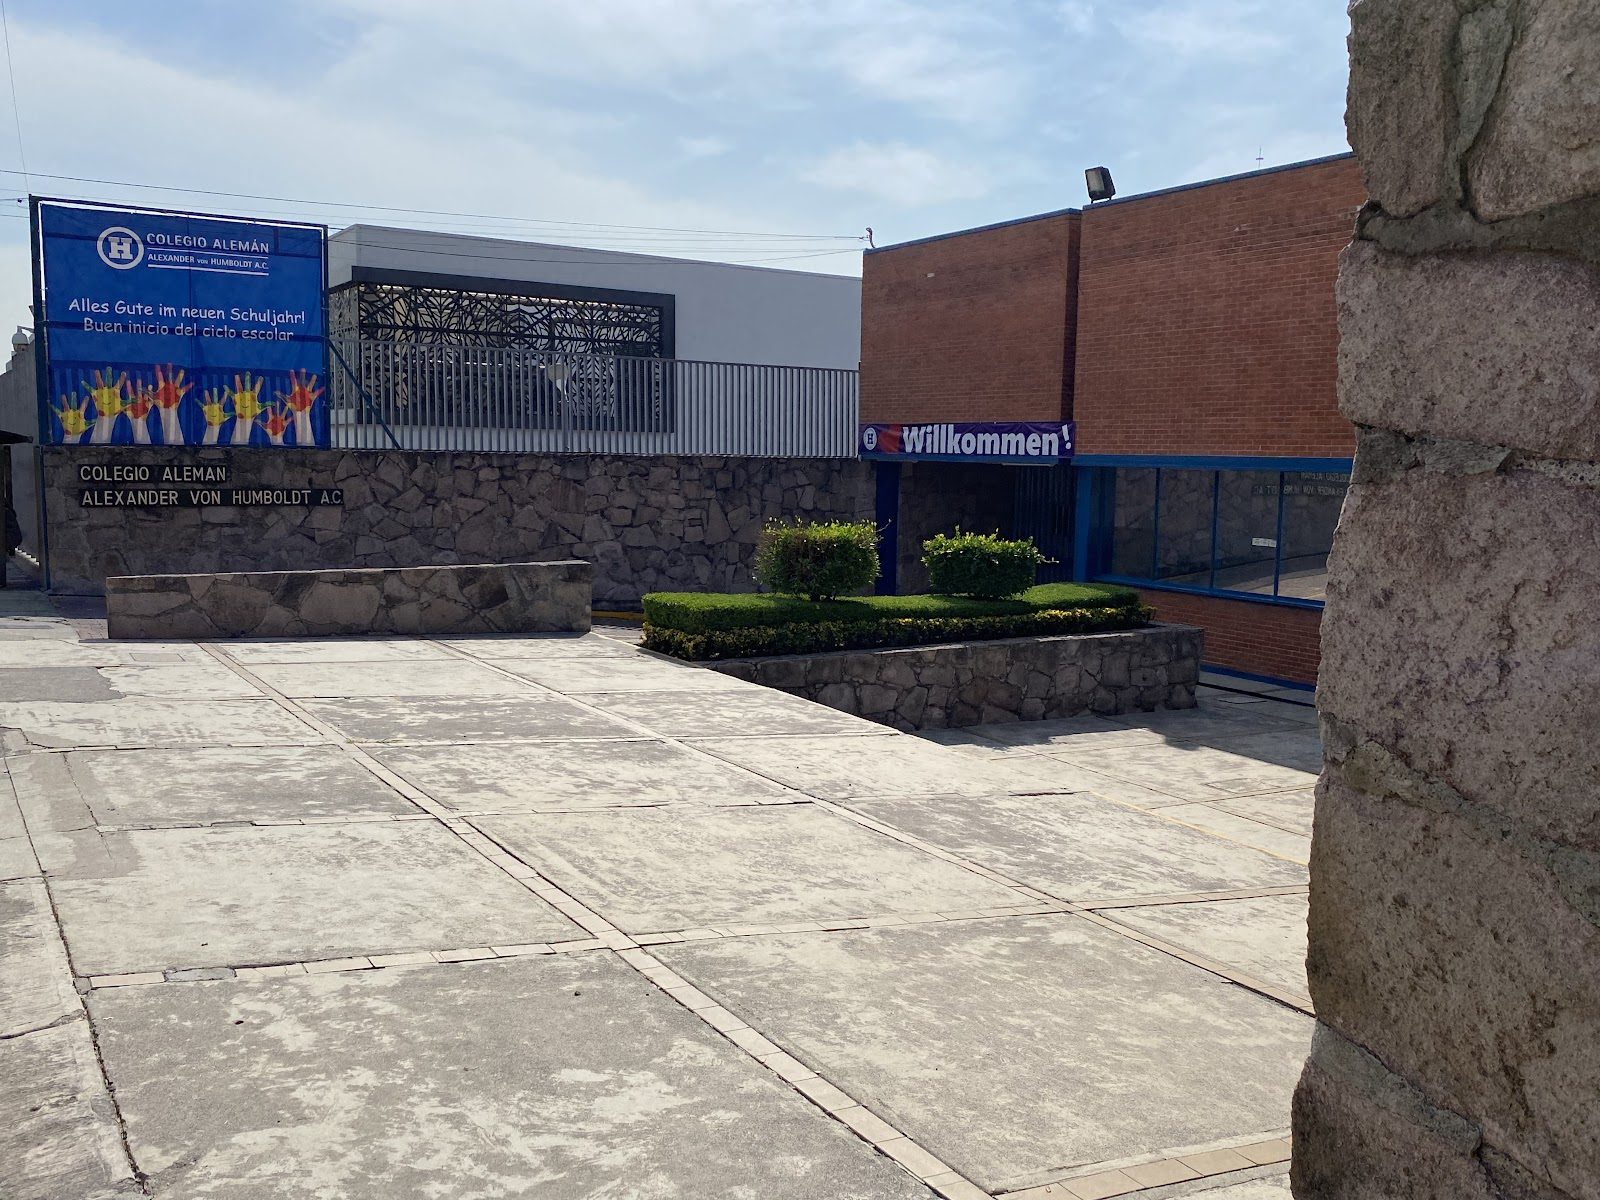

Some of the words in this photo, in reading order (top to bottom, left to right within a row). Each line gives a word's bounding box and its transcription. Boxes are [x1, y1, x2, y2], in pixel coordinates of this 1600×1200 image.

[146, 233, 207, 248] COLEGIO
[213, 239, 269, 253] ALEMÁN
[147, 253, 195, 264] ALEXANDER
[210, 258, 253, 268] HUMBOLDT
[255, 262, 269, 270] A.C.
[68, 298, 109, 313] Alles
[114, 300, 154, 316] Gute
[159, 303, 177, 317] im
[181, 307, 225, 320] neuen
[230, 308, 305, 327] Schuljahr!
[83, 317, 123, 333] Buen
[128, 320, 169, 335] inicio
[174, 322, 197, 336] del
[202, 324, 237, 339] ciclo
[241, 327, 294, 341] escolar
[902, 424, 1072, 456] Willkommen!
[80, 465, 150, 481] COLEGIO
[162, 466, 226, 481] ALEMAN
[82, 490, 179, 505] ALEXANDER
[190, 490, 221, 504] VON
[232, 490, 312, 505] HUMBOLDT
[320, 490, 343, 504] A.C.
